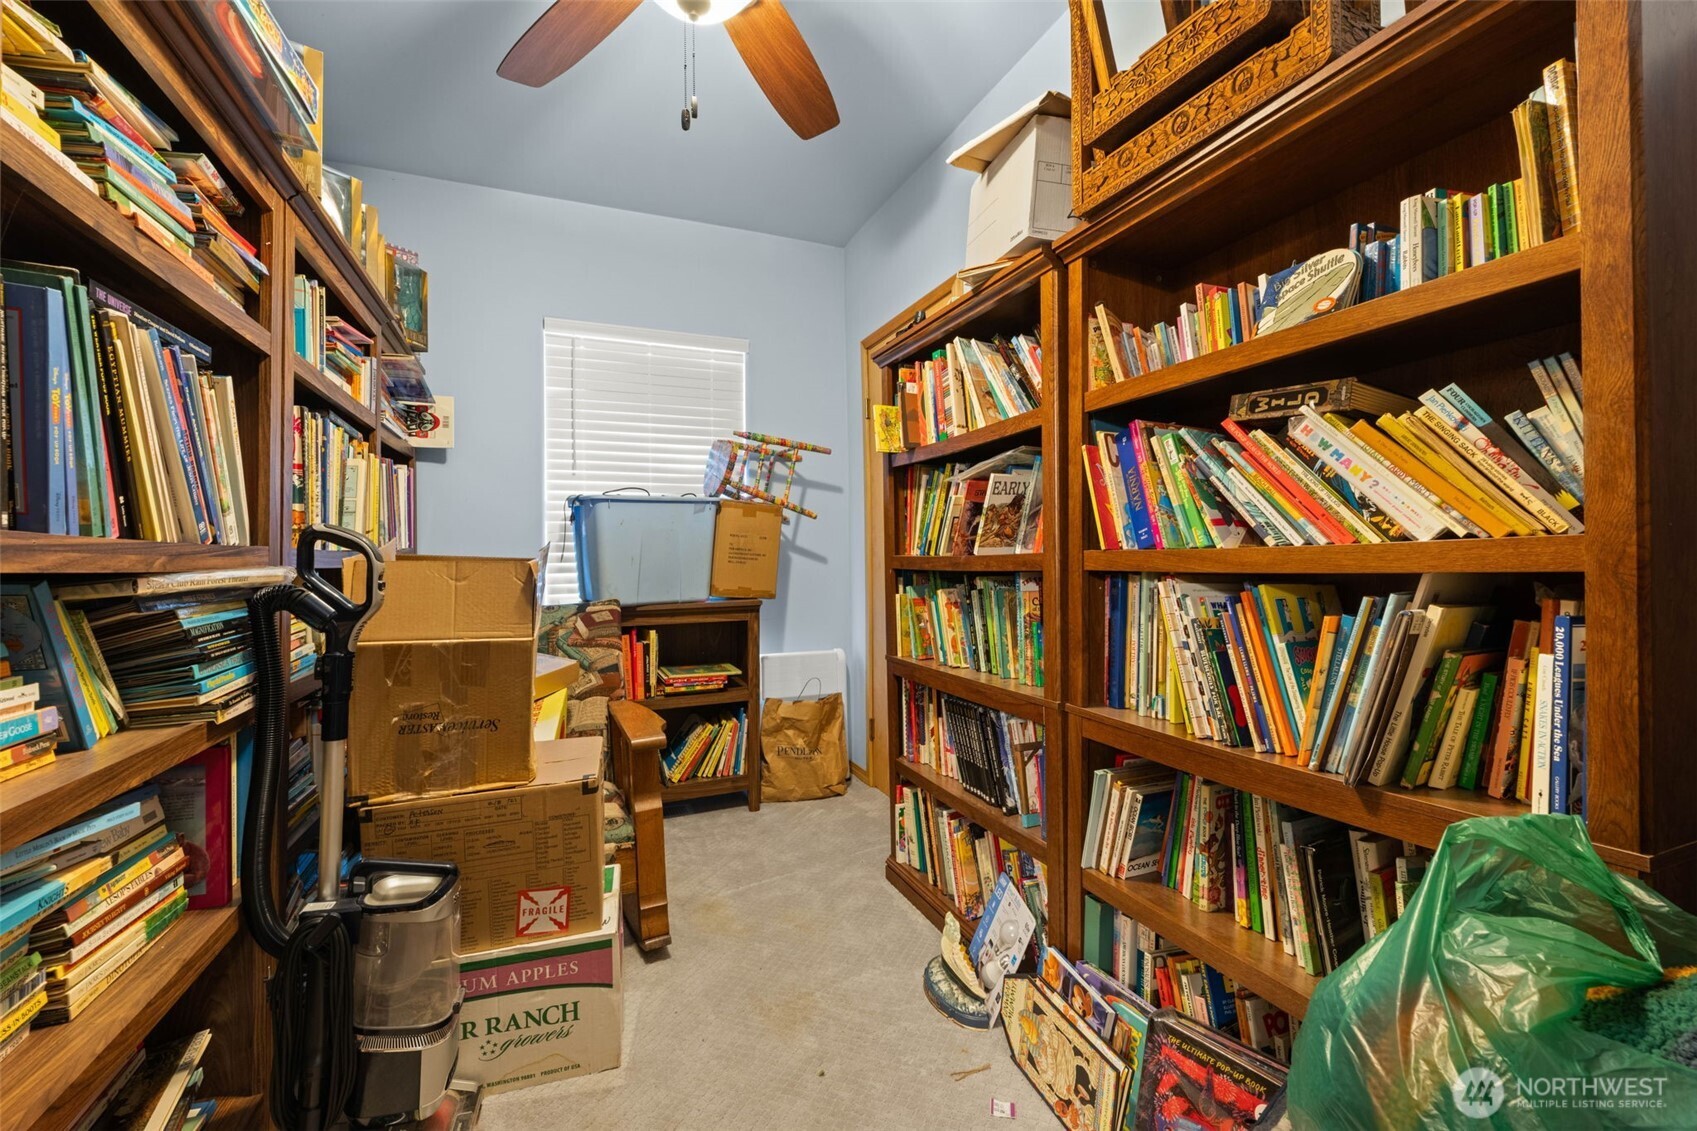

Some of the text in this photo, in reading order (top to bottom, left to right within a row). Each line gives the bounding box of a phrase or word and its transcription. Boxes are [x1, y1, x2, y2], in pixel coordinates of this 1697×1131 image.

[1275, 254, 1345, 301] Space Shuttle
[1293, 255, 1325, 280] Silver
[104, 293, 134, 316] UNIVERSE
[51, 387, 60, 406] TOY
[63, 393, 71, 410] TOY
[105, 345, 134, 462] EGYPTIAN MUMMIES
[1255, 391, 1319, 412] WILD
[1427, 393, 1440, 407] Jan
[1445, 386, 1466, 405] FOUR
[1422, 409, 1477, 459] THE SINGING SACK
[1266, 460, 1282, 476] WORLD
[992, 481, 1030, 495] EARLY
[1127, 466, 1143, 511] NARNIA
[1253, 473, 1276, 497] BEACH BALL
[1536, 507, 1559, 528] BLACK
[207, 576, 226, 584] Forest
[227, 574, 248, 583] Theater
[189, 622, 224, 636] MAGNIFICATION
[1198, 649, 1214, 689] BLUEBERRIES
[1237, 646, 1258, 703] LLAMA LLAMA PAJAMA
[1329, 647, 1343, 685] STELLALUNA
[1552, 626, 1564, 761] 20,000 Leagues Under the Sea
[398, 719, 500, 735] ServiceASTER
[403, 711, 440, 721] Restore
[1371, 709, 1402, 778] The Little House Pop-Up
[1537, 700, 1548, 768] SNAKES IN ACTION
[1129, 806, 1138, 824] OCEAN
[111, 824, 130, 847] Baby
[1127, 860, 1151, 872] OCEAN
[1316, 868, 1325, 892] Patrick
[37, 883, 70, 911] KNIGHTS
[522, 905, 565, 917] FRAGILE
[80, 919, 105, 939] JOURNEY
[506, 960, 579, 985] APPLES
[485, 1000, 580, 1036] RANCH
[490, 1024, 574, 1058] growers
[540, 1067, 563, 1077] PRODUCT
[570, 1063, 581, 1071] USA
[1168, 1034, 1267, 1093] THE ULTIMATE POP-UP BOOK
[487, 1076, 520, 1088] WASHINGTON
